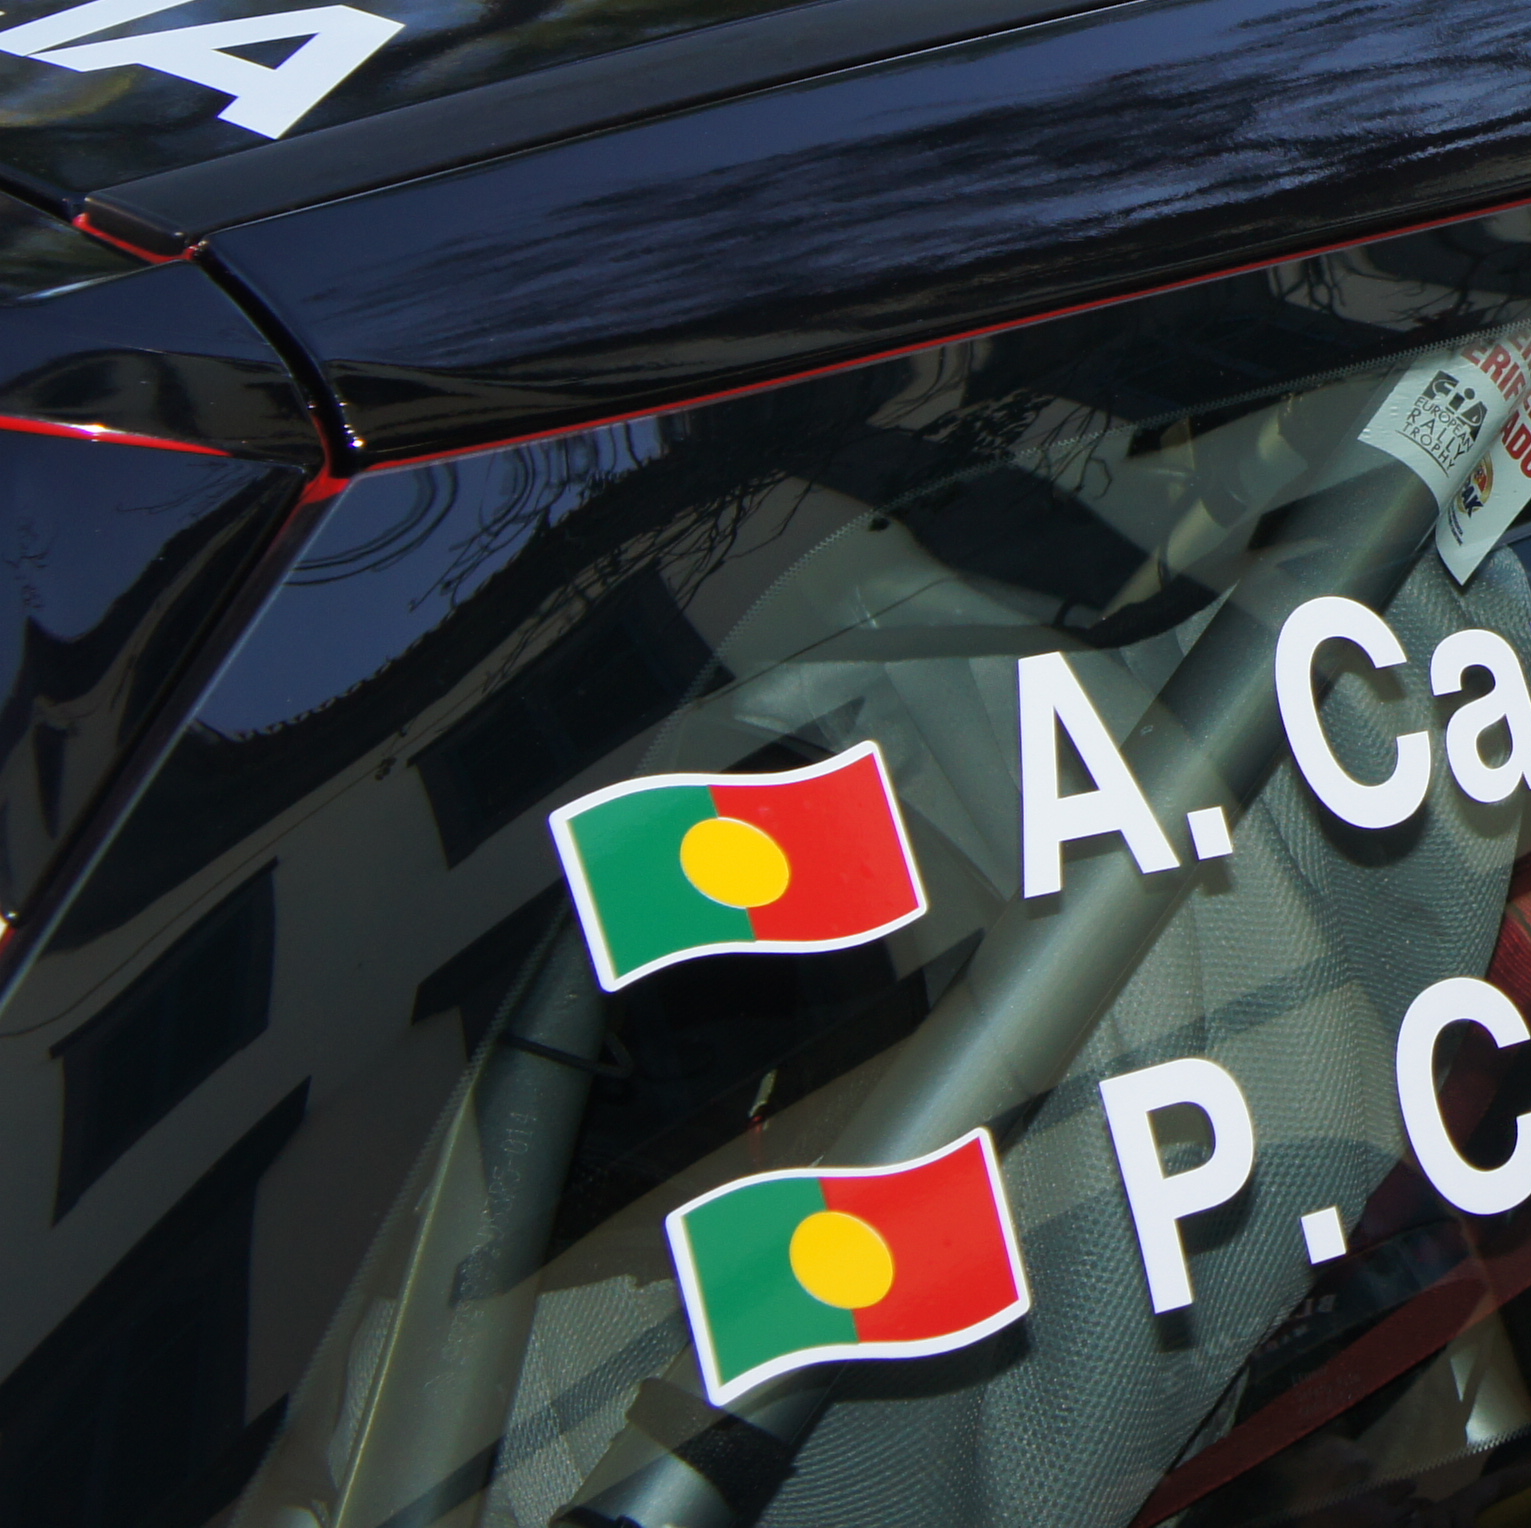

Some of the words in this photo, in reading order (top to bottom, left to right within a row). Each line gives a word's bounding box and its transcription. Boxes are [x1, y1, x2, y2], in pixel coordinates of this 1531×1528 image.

[1401, 421, 1456, 471] TROPHY
[1407, 409, 1466, 462] RALLY
[1413, 396, 1474, 454] EUROPEAN
[1017, 653, 1236, 898] A.
[1100, 1057, 1347, 1314] P.
